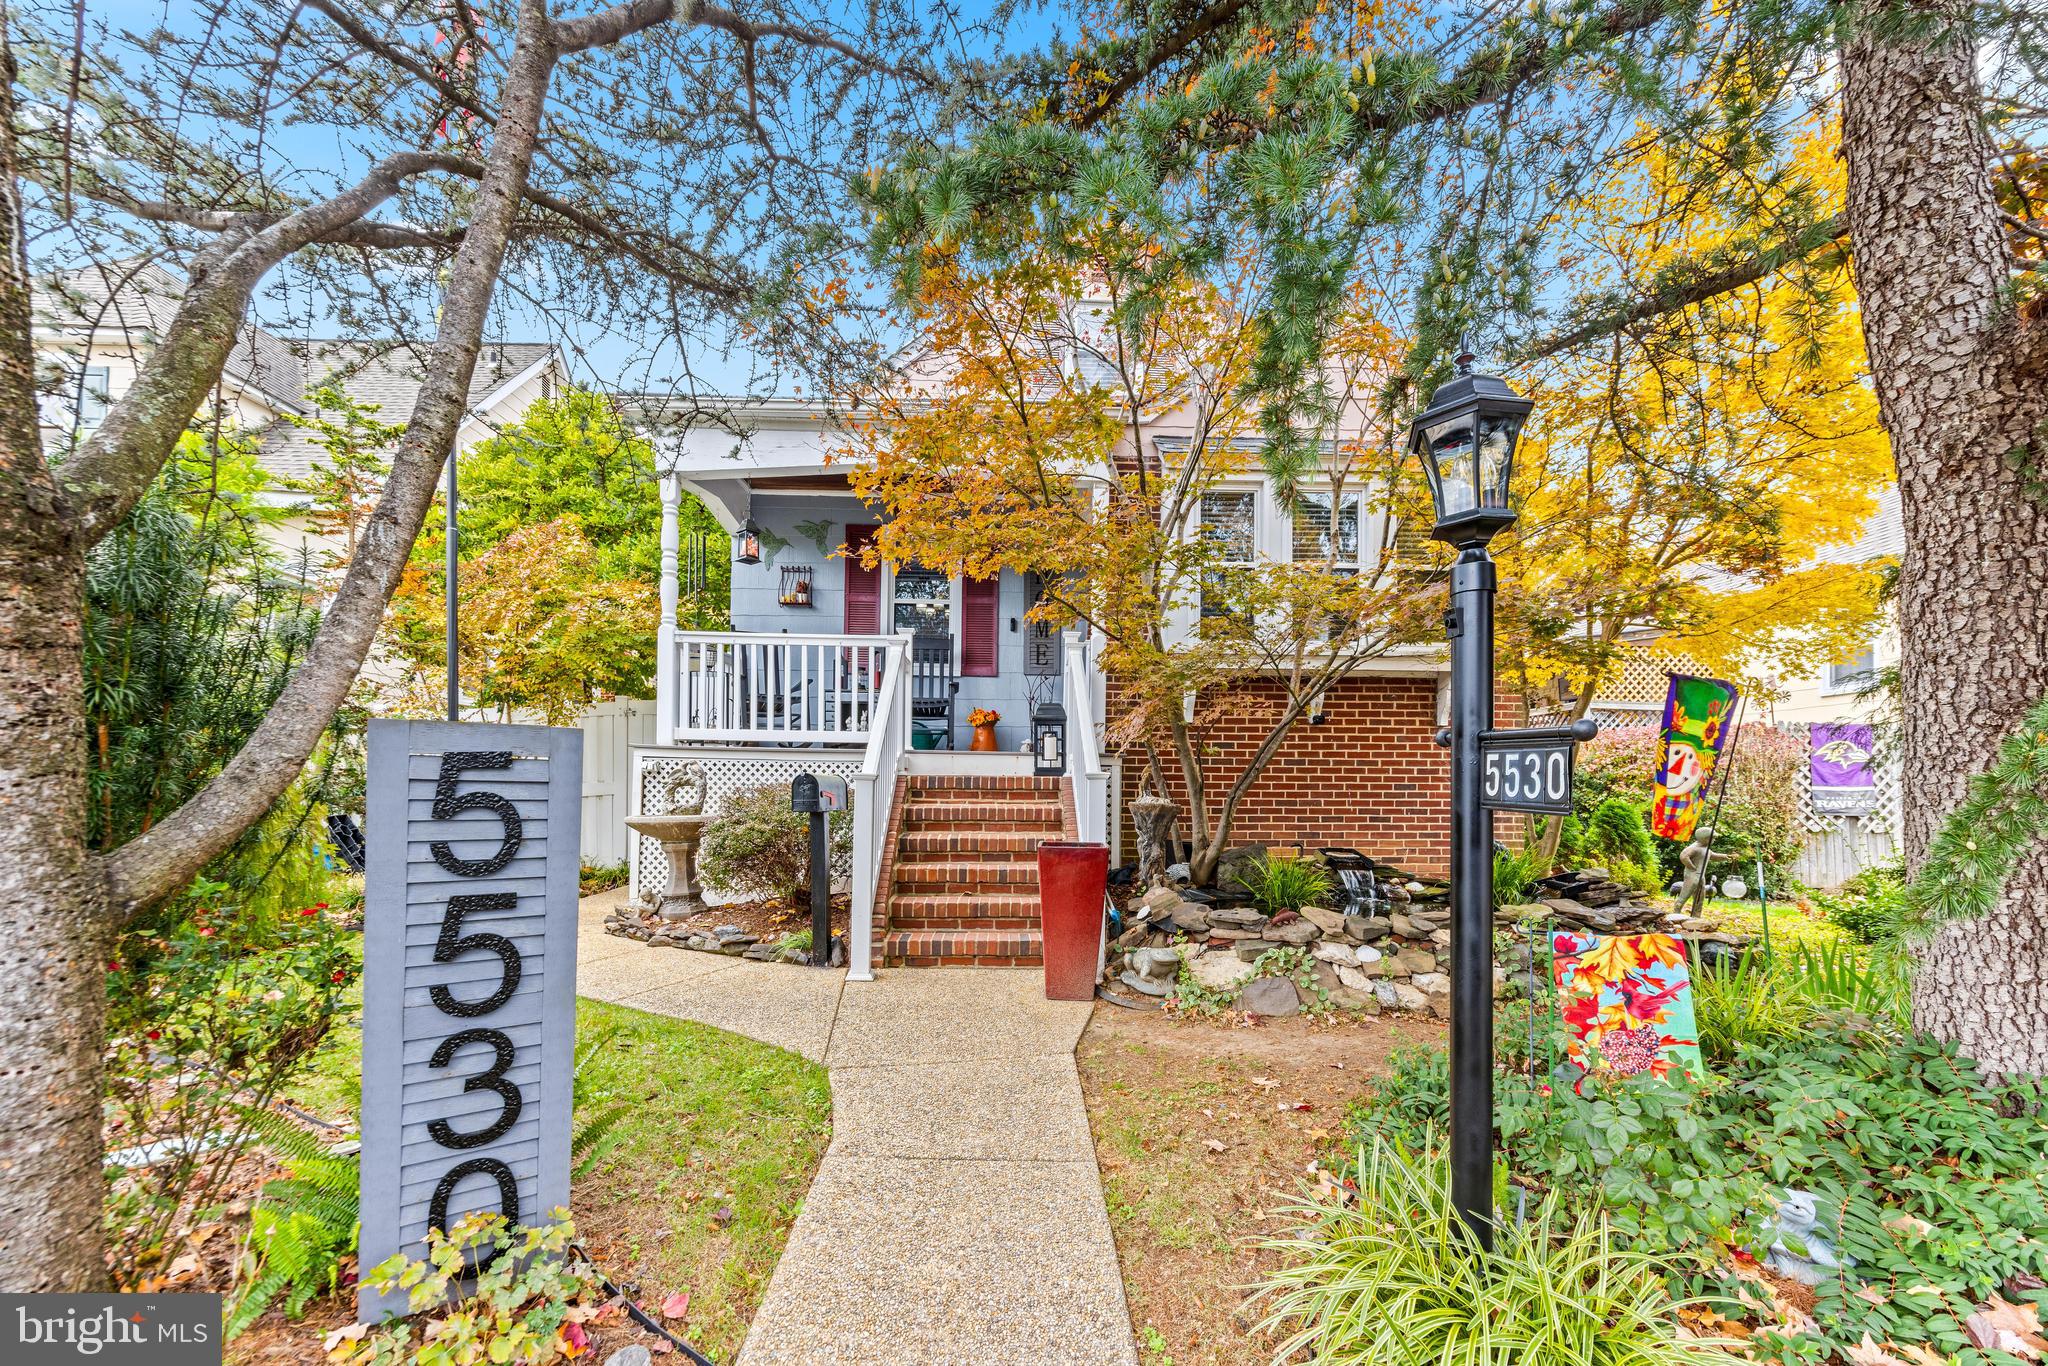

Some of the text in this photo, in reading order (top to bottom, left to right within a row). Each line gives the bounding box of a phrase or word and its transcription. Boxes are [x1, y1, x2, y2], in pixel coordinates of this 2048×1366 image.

[1485, 752, 1566, 800] 5530
[1815, 799, 1878, 808] RAVENS
[427, 750, 523, 1281] 5530
